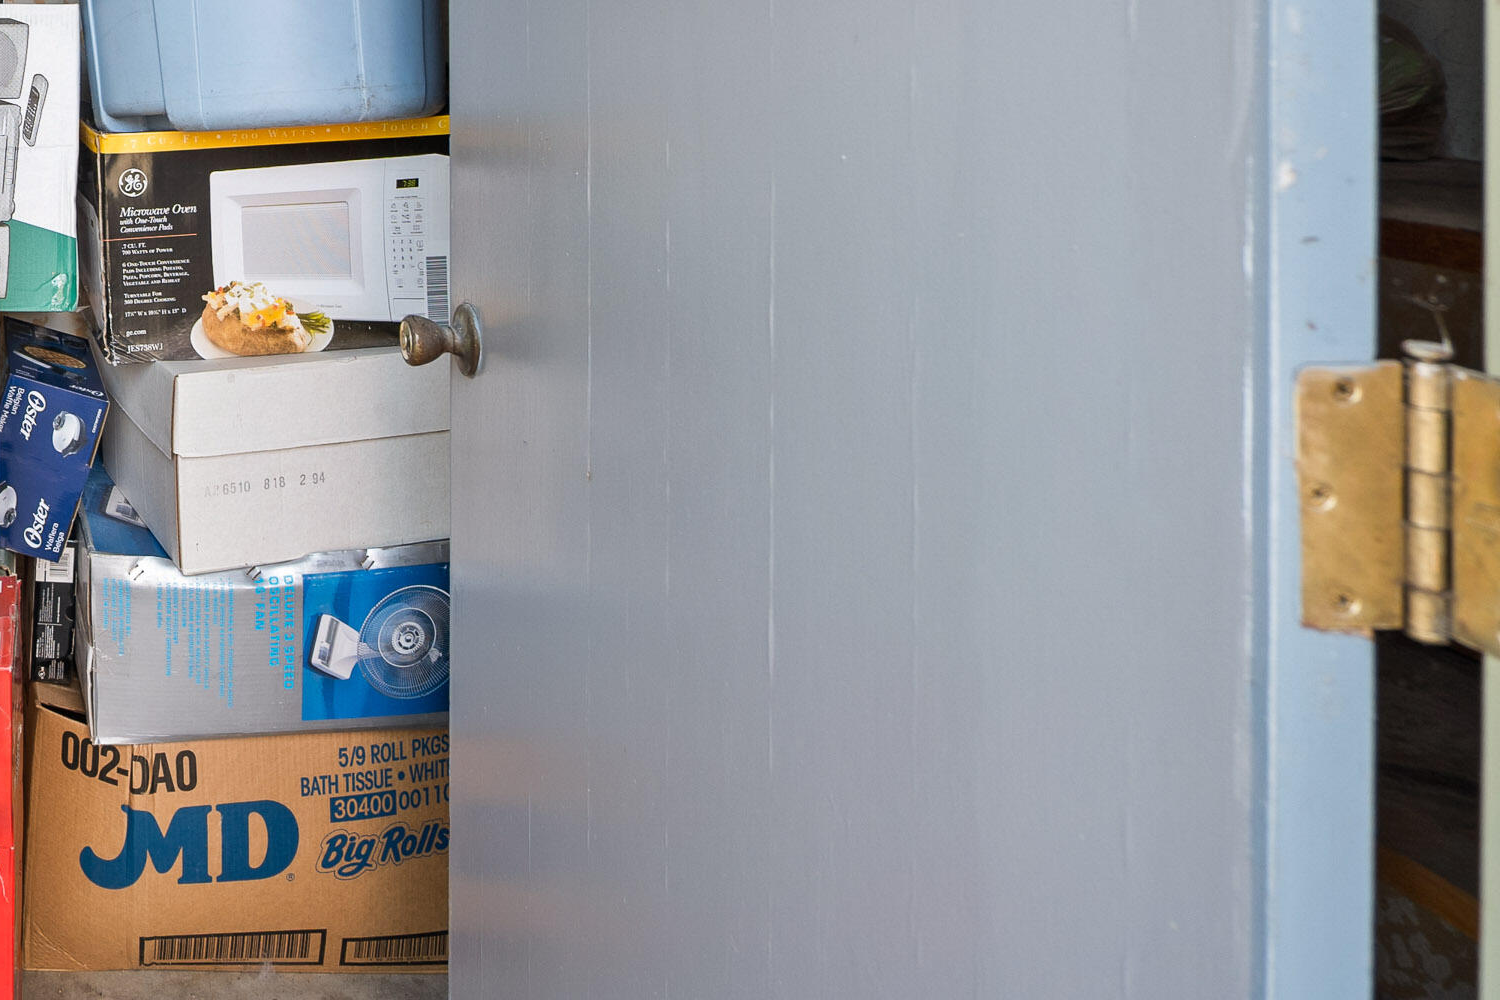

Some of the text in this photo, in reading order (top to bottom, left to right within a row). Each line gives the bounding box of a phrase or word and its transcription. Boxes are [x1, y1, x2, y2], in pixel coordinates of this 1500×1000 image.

[119, 203, 198, 217] Microwave Oven
[135, 216, 168, 224] One-Touch
[120, 223, 173, 233] Convenience Pads
[126, 329, 147, 338] ge.com
[4, 386, 17, 410] Waffle
[11, 388, 25, 415] Belgian
[20, 390, 46, 441] Oster
[263, 476, 286, 490] 818
[299, 474, 306, 486] 2
[312, 472, 326, 485] 94
[24, 498, 50, 548] Oster
[52, 532, 65, 553] Belga
[283, 575, 294, 628] DELUXE
[254, 603, 266, 631] FAN
[269, 576, 280, 667] OSCILLATING
[283, 646, 294, 690] SPEED
[339, 734, 449, 767] 5/9 ROLL PKGS
[301, 775, 339, 797] BATH
[343, 768, 393, 792] TISSUE
[334, 794, 393, 819] 30400
[322, 823, 450, 877] Big Rolls
